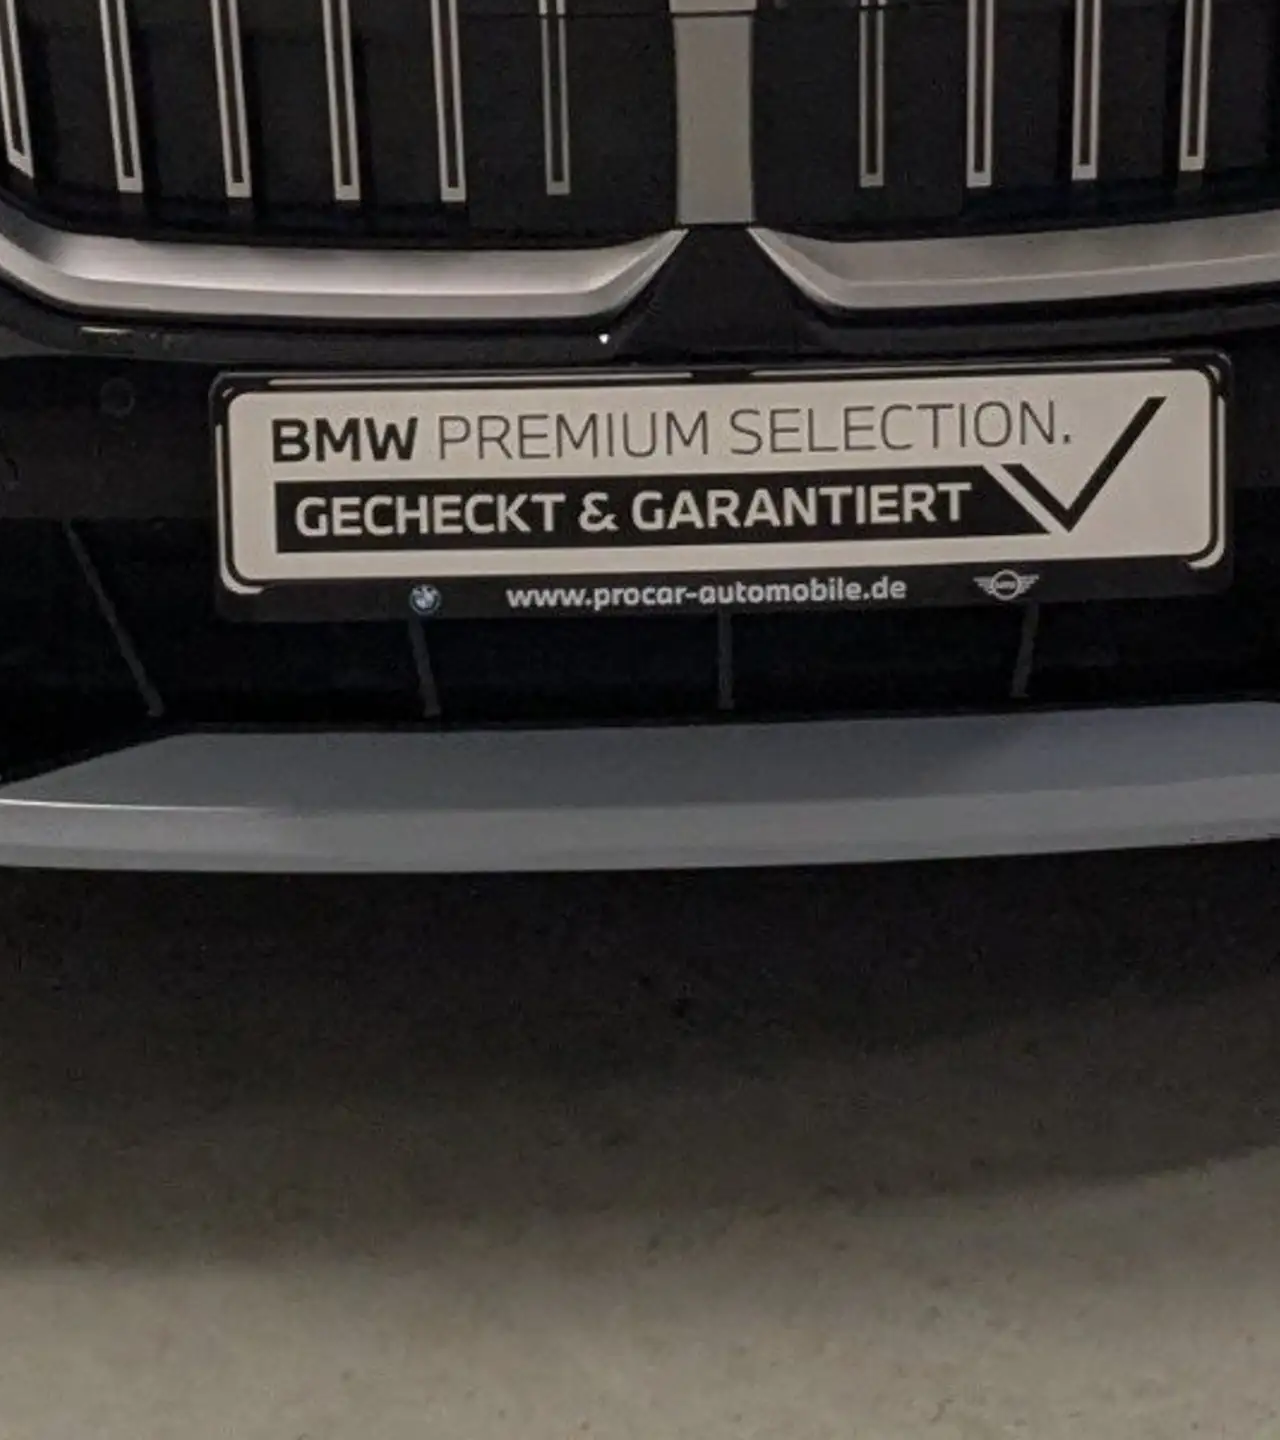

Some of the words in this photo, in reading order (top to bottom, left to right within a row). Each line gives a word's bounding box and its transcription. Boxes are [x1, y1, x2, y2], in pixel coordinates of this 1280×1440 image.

[271, 415, 418, 463] BMW
[437, 409, 709, 461] PREMIUM
[728, 398, 1072, 457] SELECTION.
[294, 491, 565, 538] GECHECKT
[578, 490, 619, 533] &
[630, 481, 972, 531] GARANTIERT
[505, 575, 907, 613] www.procar-automobile.de
